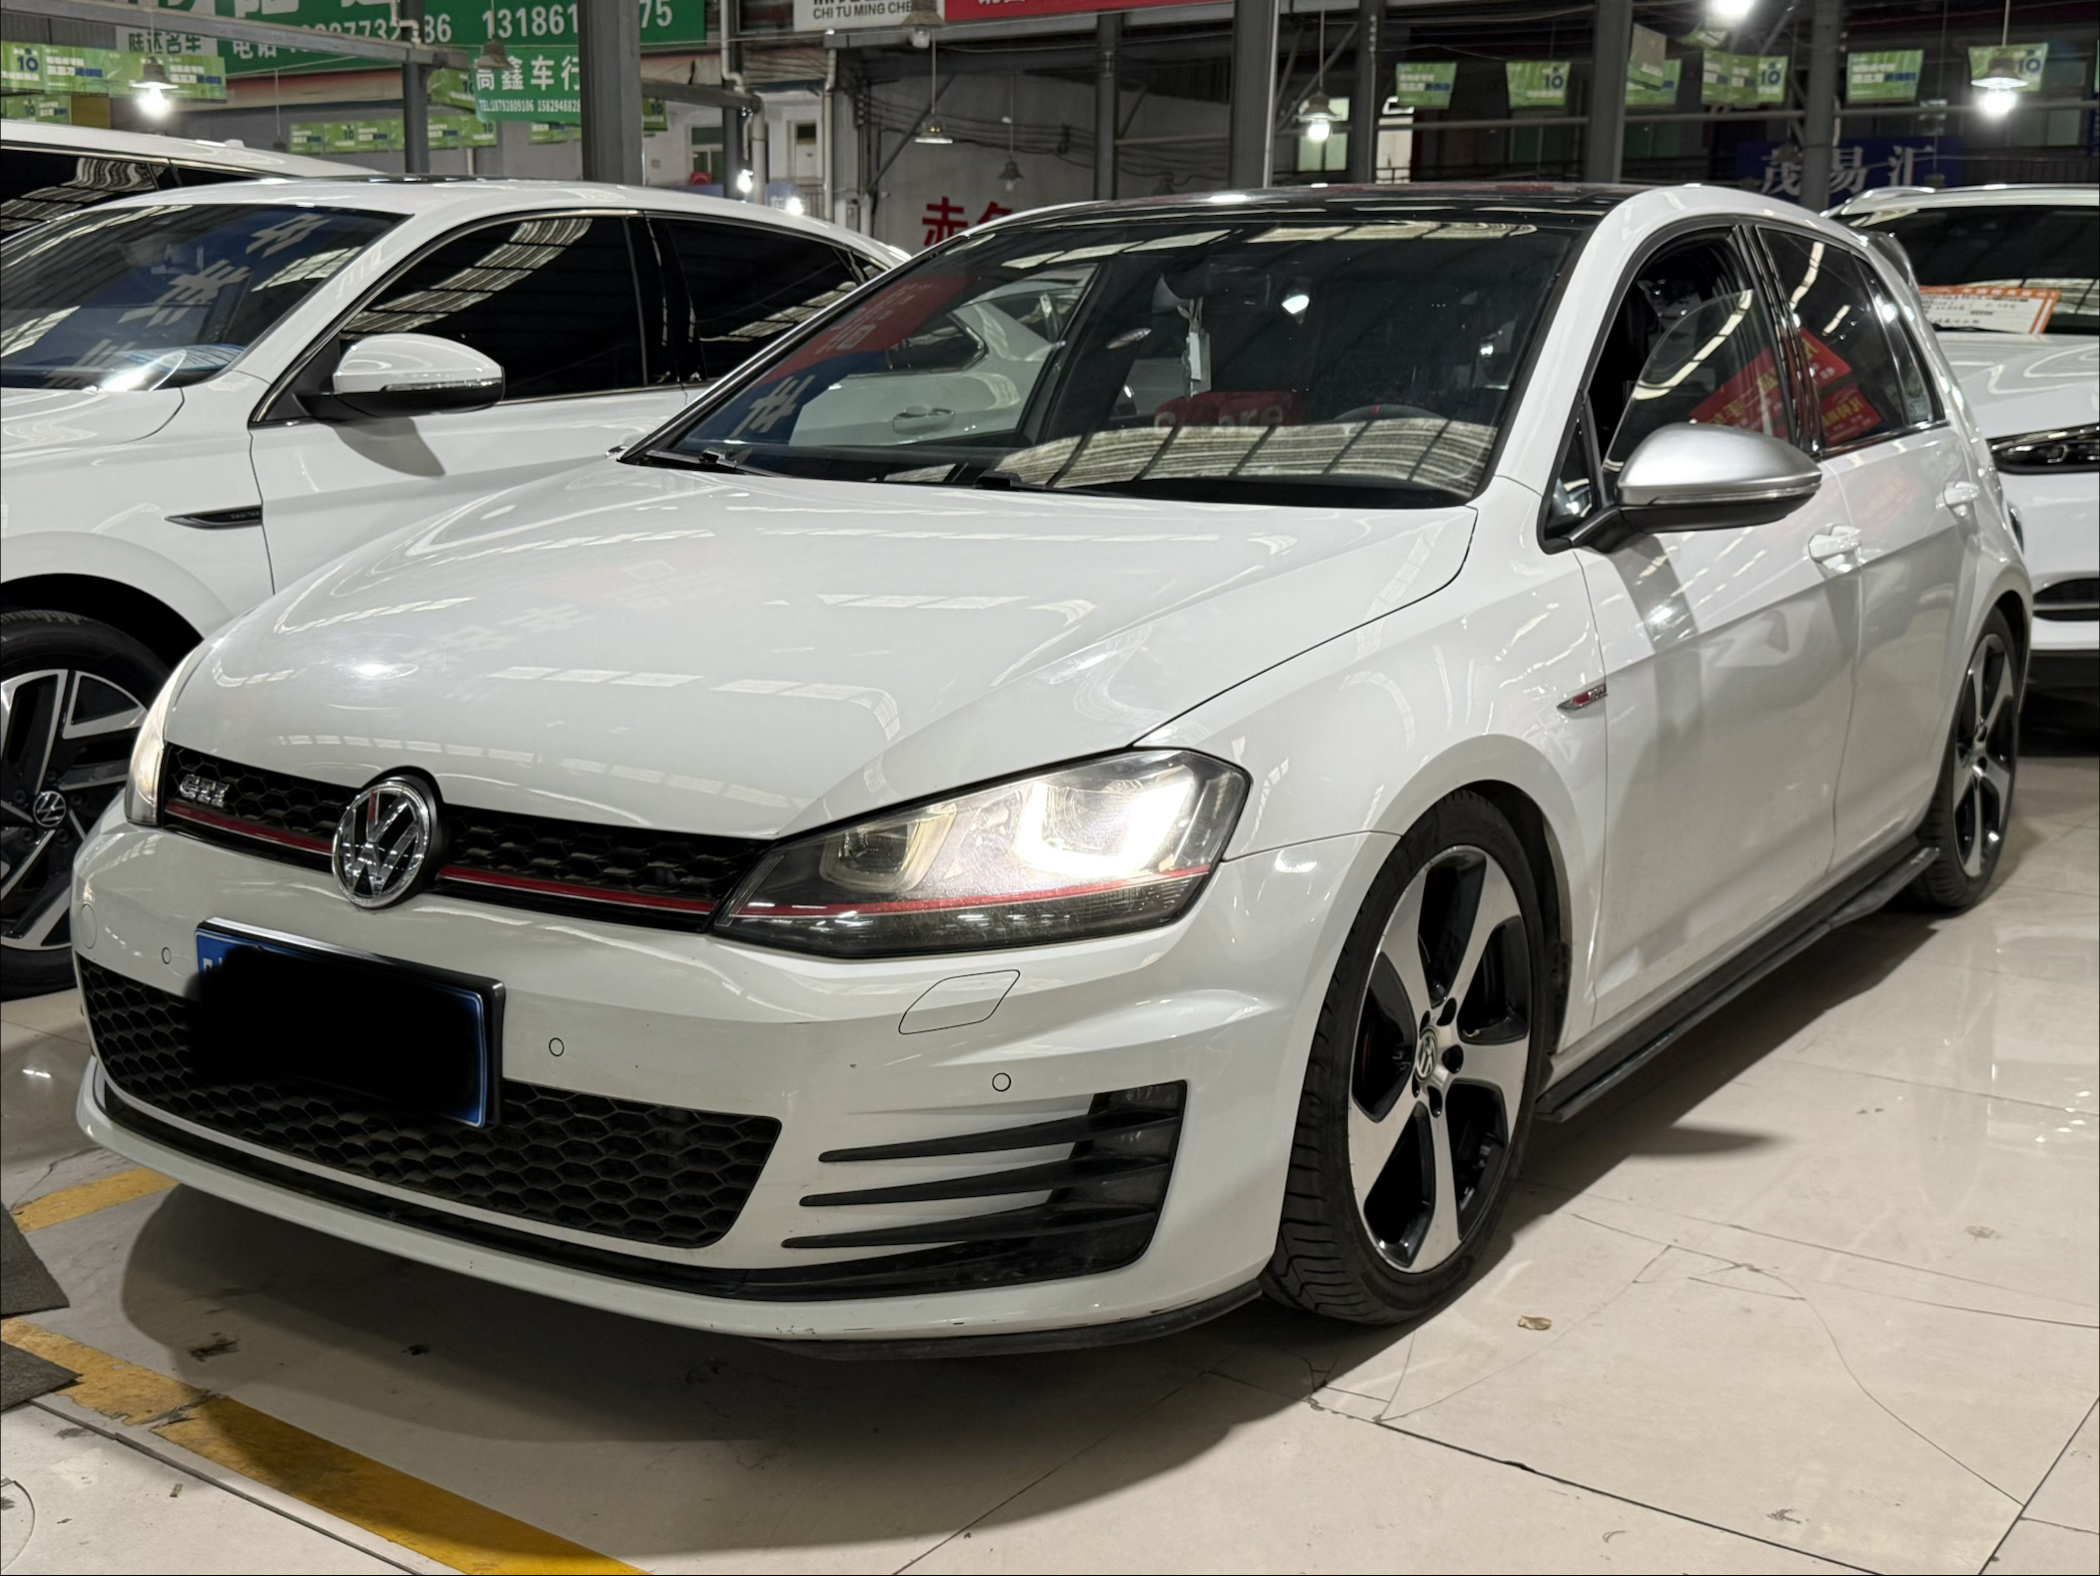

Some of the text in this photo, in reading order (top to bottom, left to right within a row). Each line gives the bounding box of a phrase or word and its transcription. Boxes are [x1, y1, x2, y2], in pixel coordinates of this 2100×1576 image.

[813, 8, 834, 20] CHI
[836, 6, 852, 17] TU
[854, 4, 885, 17] MING
[17, 56, 39, 72] 10
[1545, 74, 1564, 90] 10
[1761, 70, 1781, 85] 10
